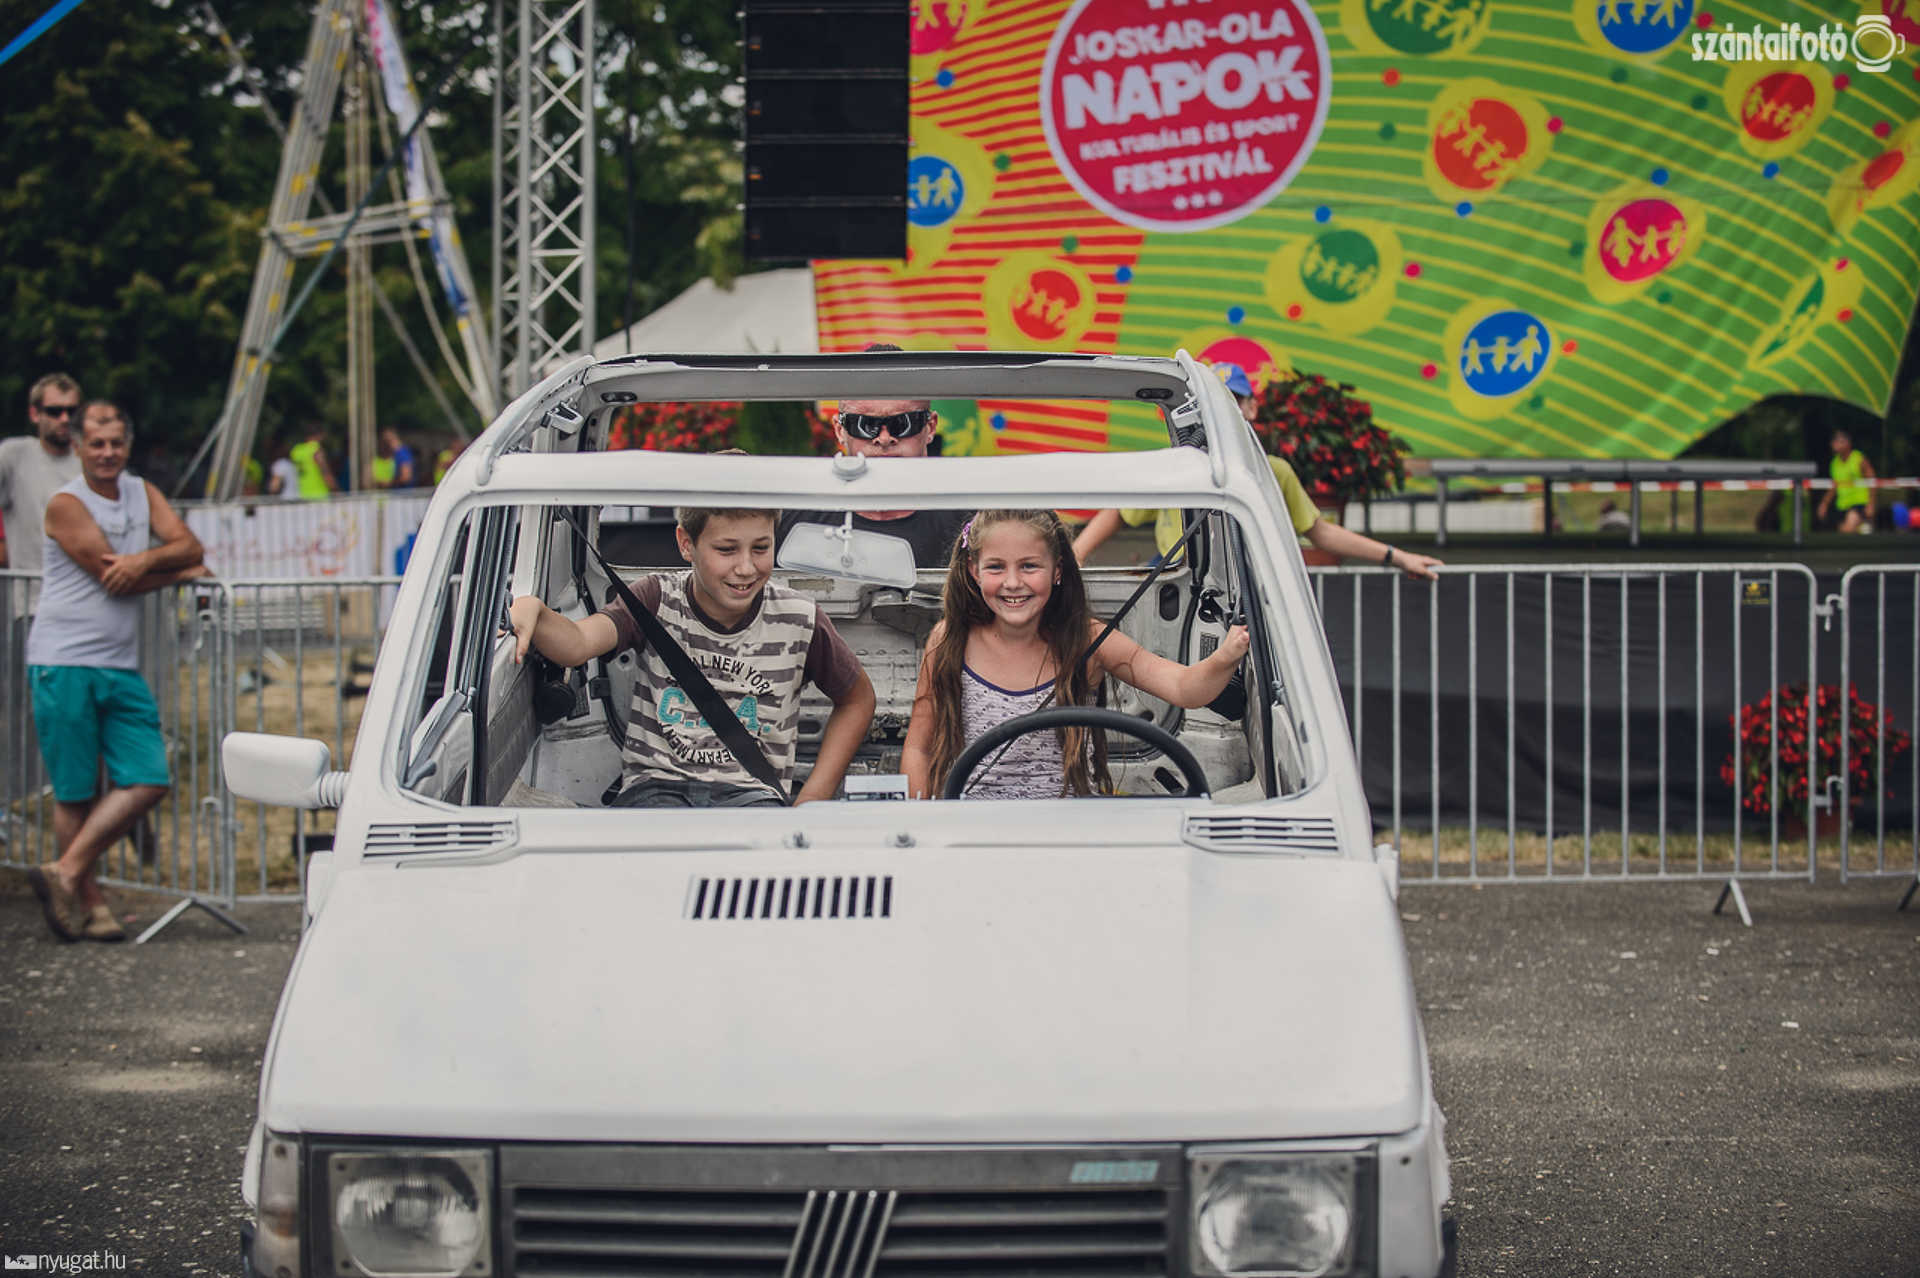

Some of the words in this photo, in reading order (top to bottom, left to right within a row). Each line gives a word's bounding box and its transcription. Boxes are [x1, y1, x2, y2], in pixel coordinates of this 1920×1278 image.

[1069, 9, 1295, 64] JOSKAR-OLA
[1061, 46, 1313, 129] NAPOK
[1204, 121, 1230, 144] ÉS
[1232, 113, 1300, 140] SPORT
[1112, 142, 1273, 194] FESZTIVÁL
[712, 655, 745, 675] NEW
[661, 723, 734, 764] EPARTMEN
